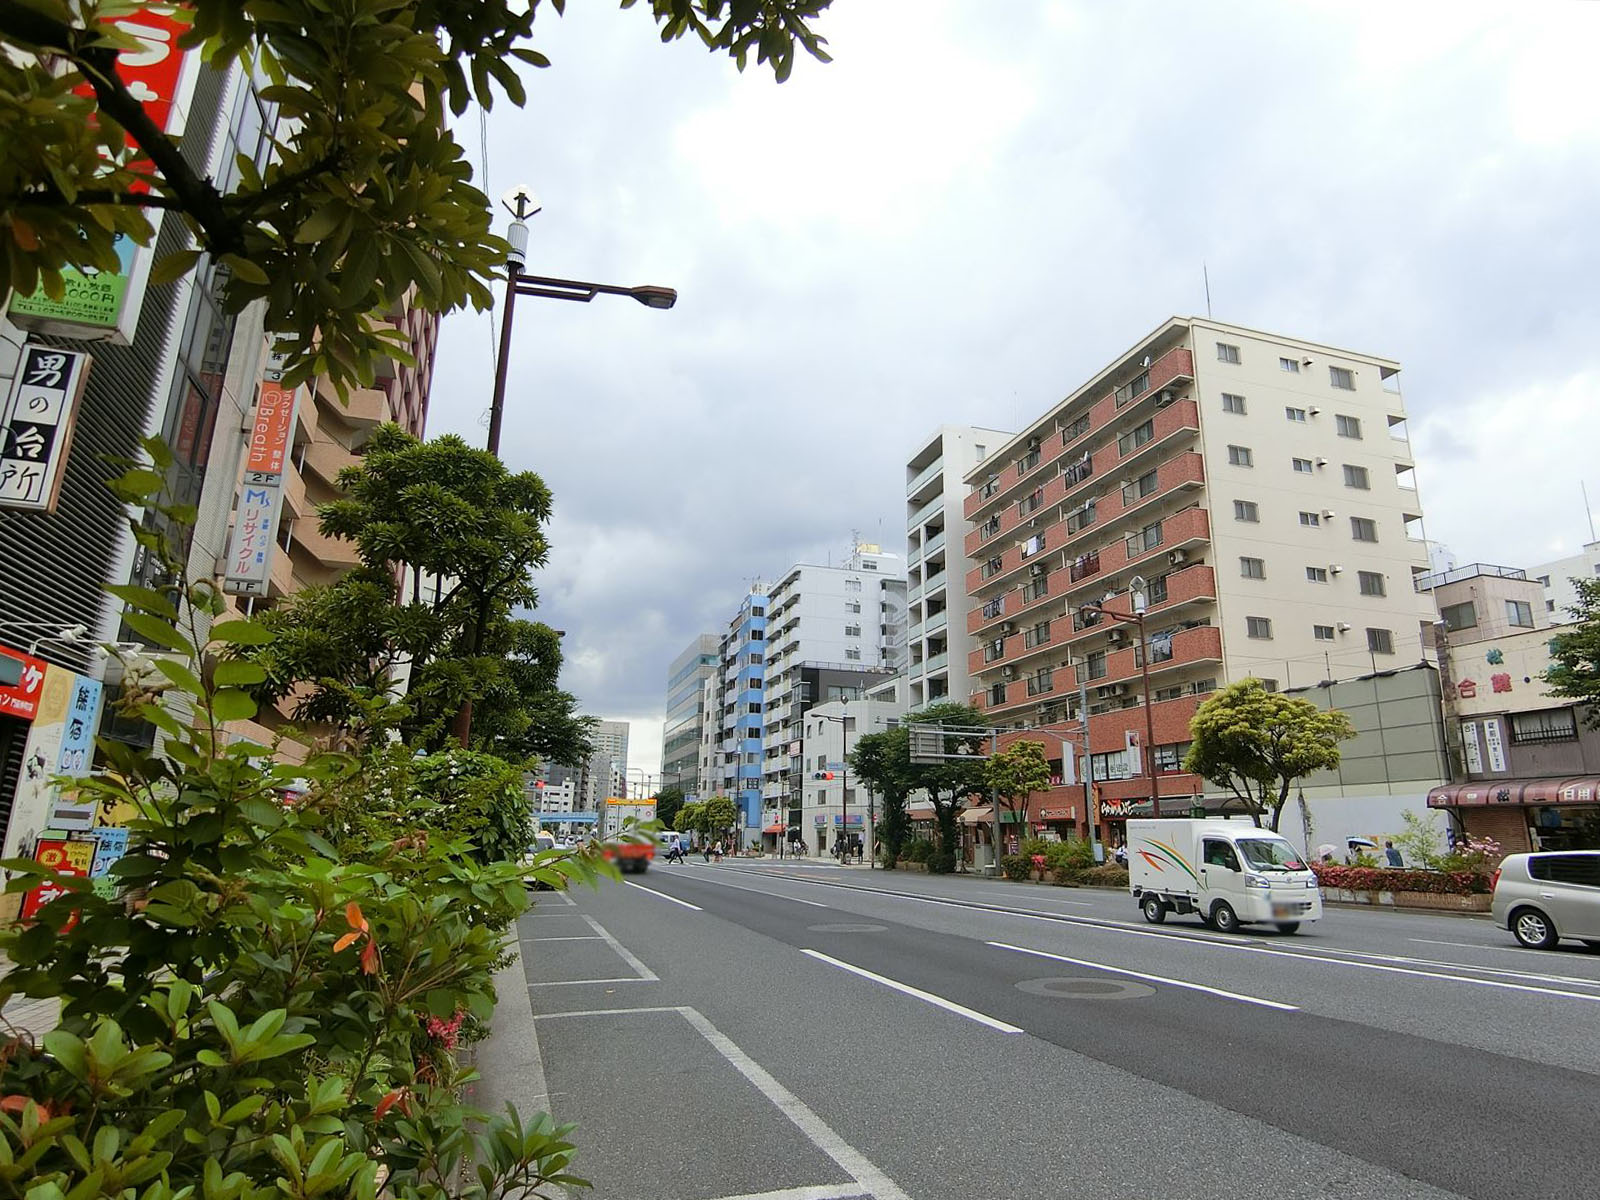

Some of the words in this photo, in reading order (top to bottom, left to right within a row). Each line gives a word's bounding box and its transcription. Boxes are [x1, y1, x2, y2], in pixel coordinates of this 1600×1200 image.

[64, 288, 115, 304] 000円
[0, 354, 67, 500] 男の台所
[251, 407, 274, 462] Breath
[252, 473, 275, 482] 2F
[235, 509, 259, 574] リサイクル
[235, 582, 256, 591] 1F
